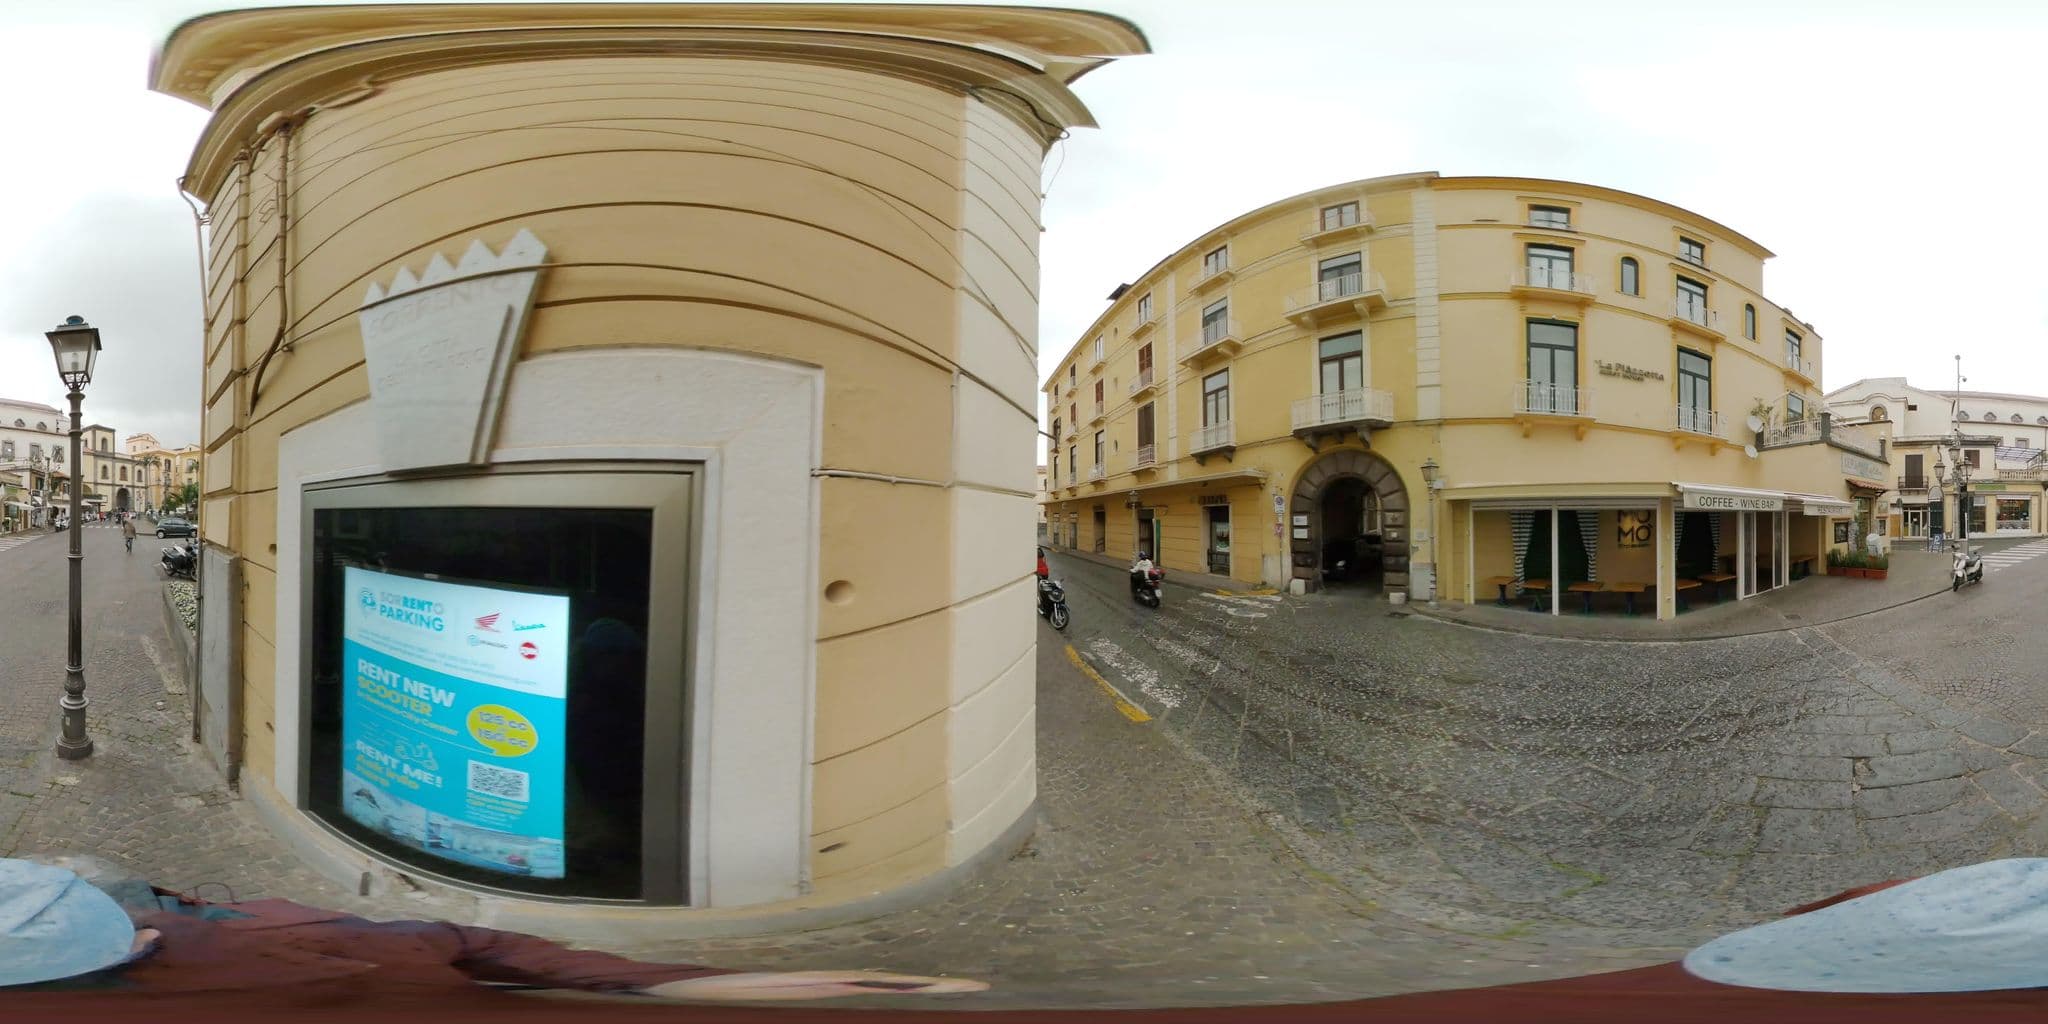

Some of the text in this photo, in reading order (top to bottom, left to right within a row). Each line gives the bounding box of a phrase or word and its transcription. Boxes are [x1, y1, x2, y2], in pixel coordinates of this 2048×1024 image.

[1699, 496, 1734, 508] COFFEE
[1740, 498, 1760, 509] WINE
[1761, 500, 1775, 509] BAR
[380, 604, 444, 632] PARKING
[357, 658, 456, 708] RENT NEW
[357, 675, 432, 717] SCOOTER
[356, 739, 399, 770] RENT
[402, 762, 442, 789] ME!
